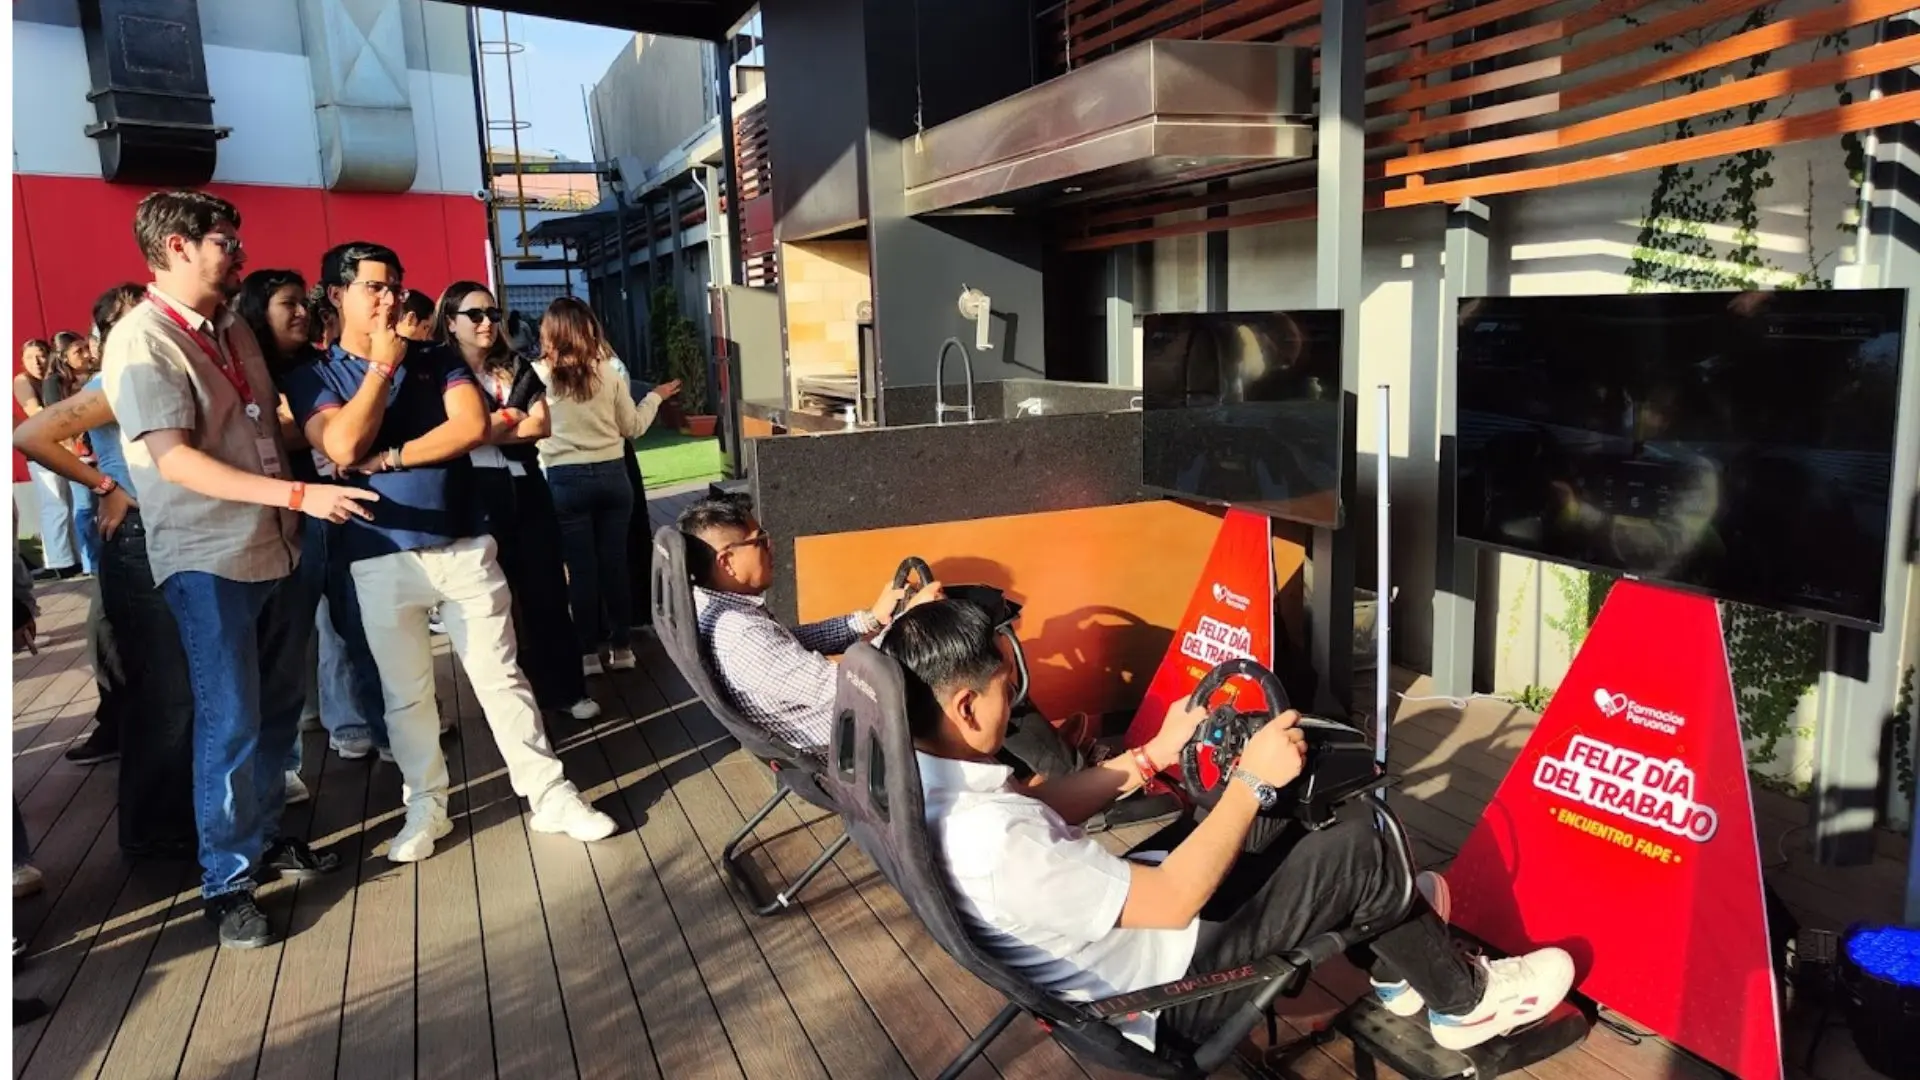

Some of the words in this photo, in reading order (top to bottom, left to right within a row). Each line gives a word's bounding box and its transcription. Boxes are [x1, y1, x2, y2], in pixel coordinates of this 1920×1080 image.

[1184, 635, 1202, 656] DEL
[1205, 643, 1241, 663] TRAB
[1200, 620, 1230, 644] FELIZ
[1229, 629, 1249, 653] DÍA
[1570, 741, 1640, 781] FELIZ
[1642, 765, 1691, 799] DÍA
[1539, 762, 1581, 795] DEL
[1589, 776, 1712, 836] TRABAJO
[1557, 808, 1634, 848] ENCUENTRO
[1634, 838, 1673, 864] FAPE
